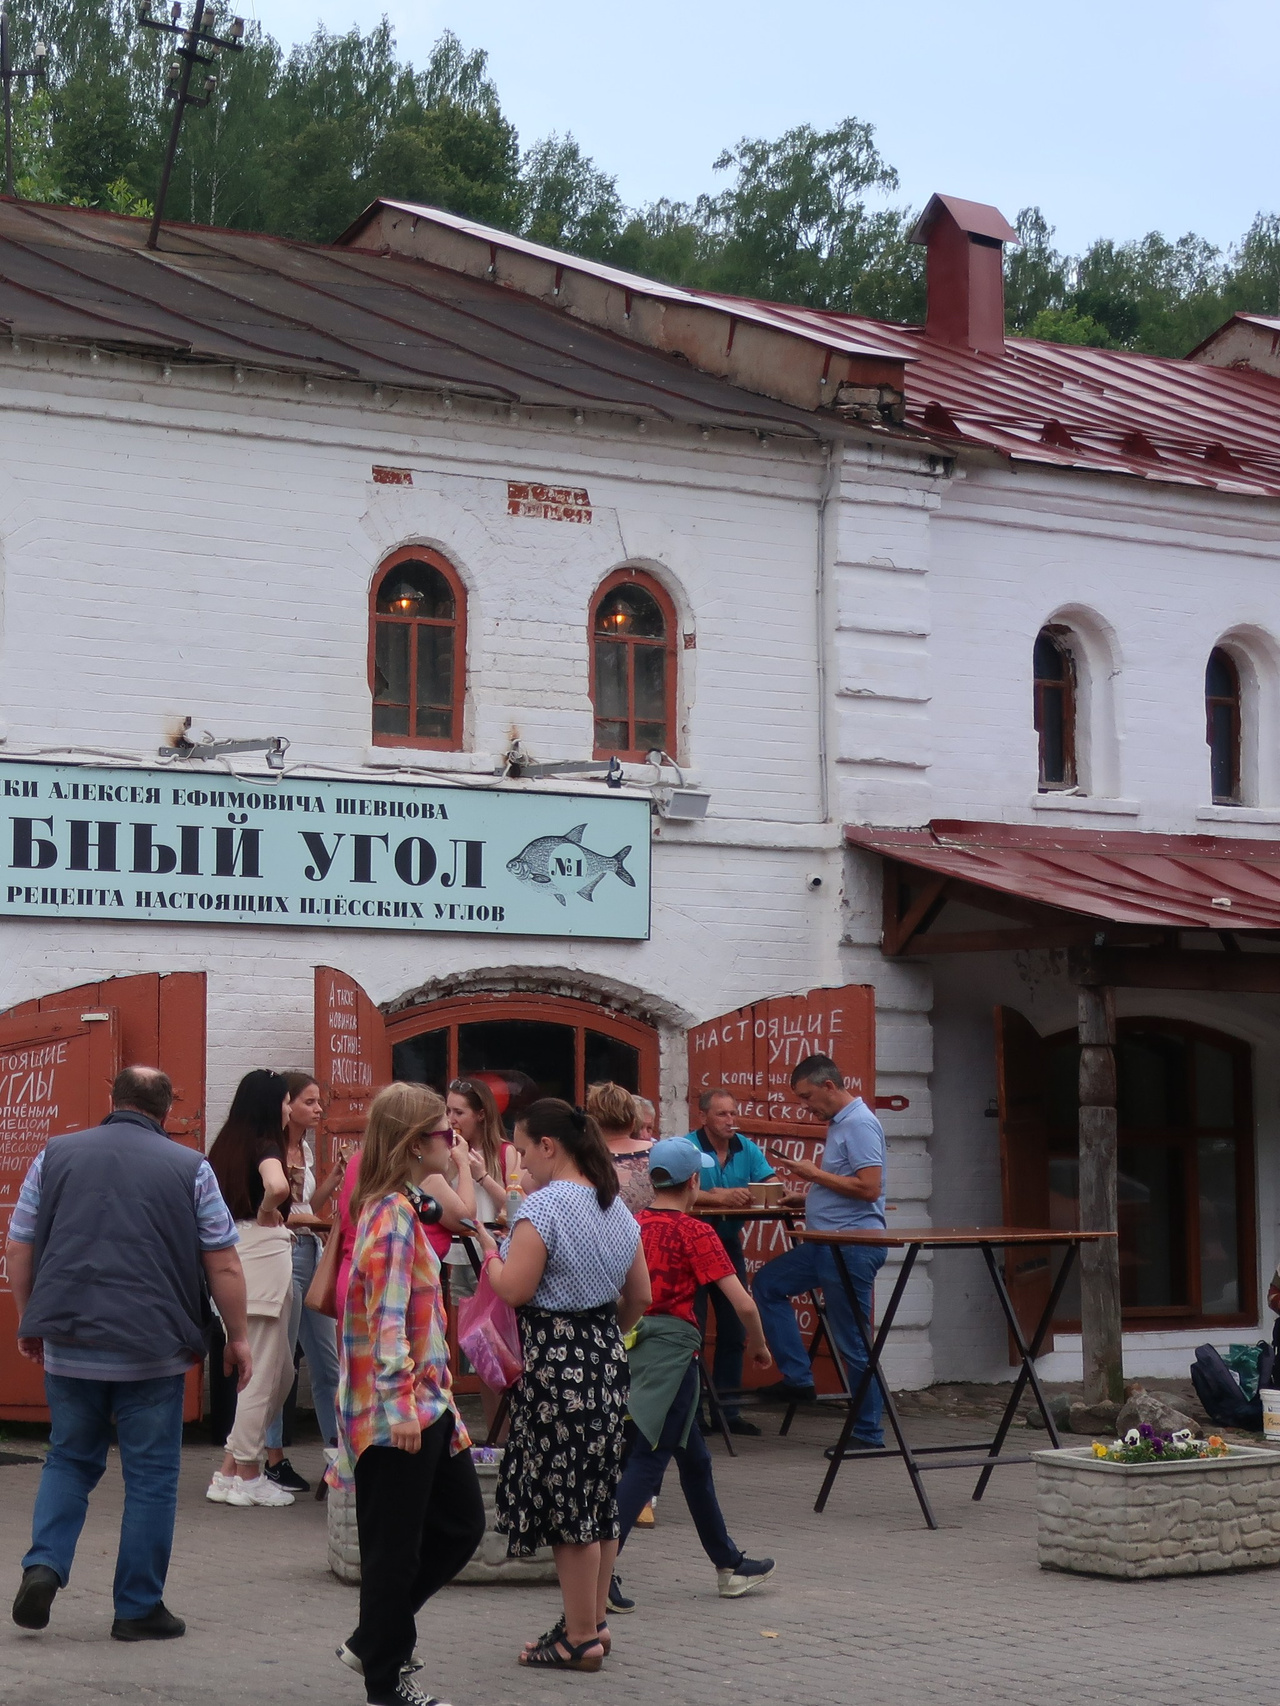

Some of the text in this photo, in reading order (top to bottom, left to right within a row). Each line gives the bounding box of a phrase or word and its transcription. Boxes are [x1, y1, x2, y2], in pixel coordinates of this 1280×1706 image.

[48, 781, 161, 804] АЛЕКСЕЯ
[172, 788, 326, 813] ЕФИМОВИЧА
[335, 798, 449, 821] ШЕВЦОВА
[297, 831, 488, 889] УГОЛ
[550, 856, 584, 878] №1
[9, 885, 125, 910] РЕЦЕПТА
[135, 890, 289, 915] НАСТОЯЩИХ
[300, 893, 424, 919] ПЛЁССКИХ
[434, 903, 505, 922] УГЛОВ
[330, 1034, 362, 1055] СЫТНЫЕ
[695, 1009, 844, 1053] НАСТОЯЩИЕ
[769, 1037, 834, 1066] УГЛЫ
[701, 1072, 710, 1086] С
[768, 1092, 785, 1103] ИЗ
